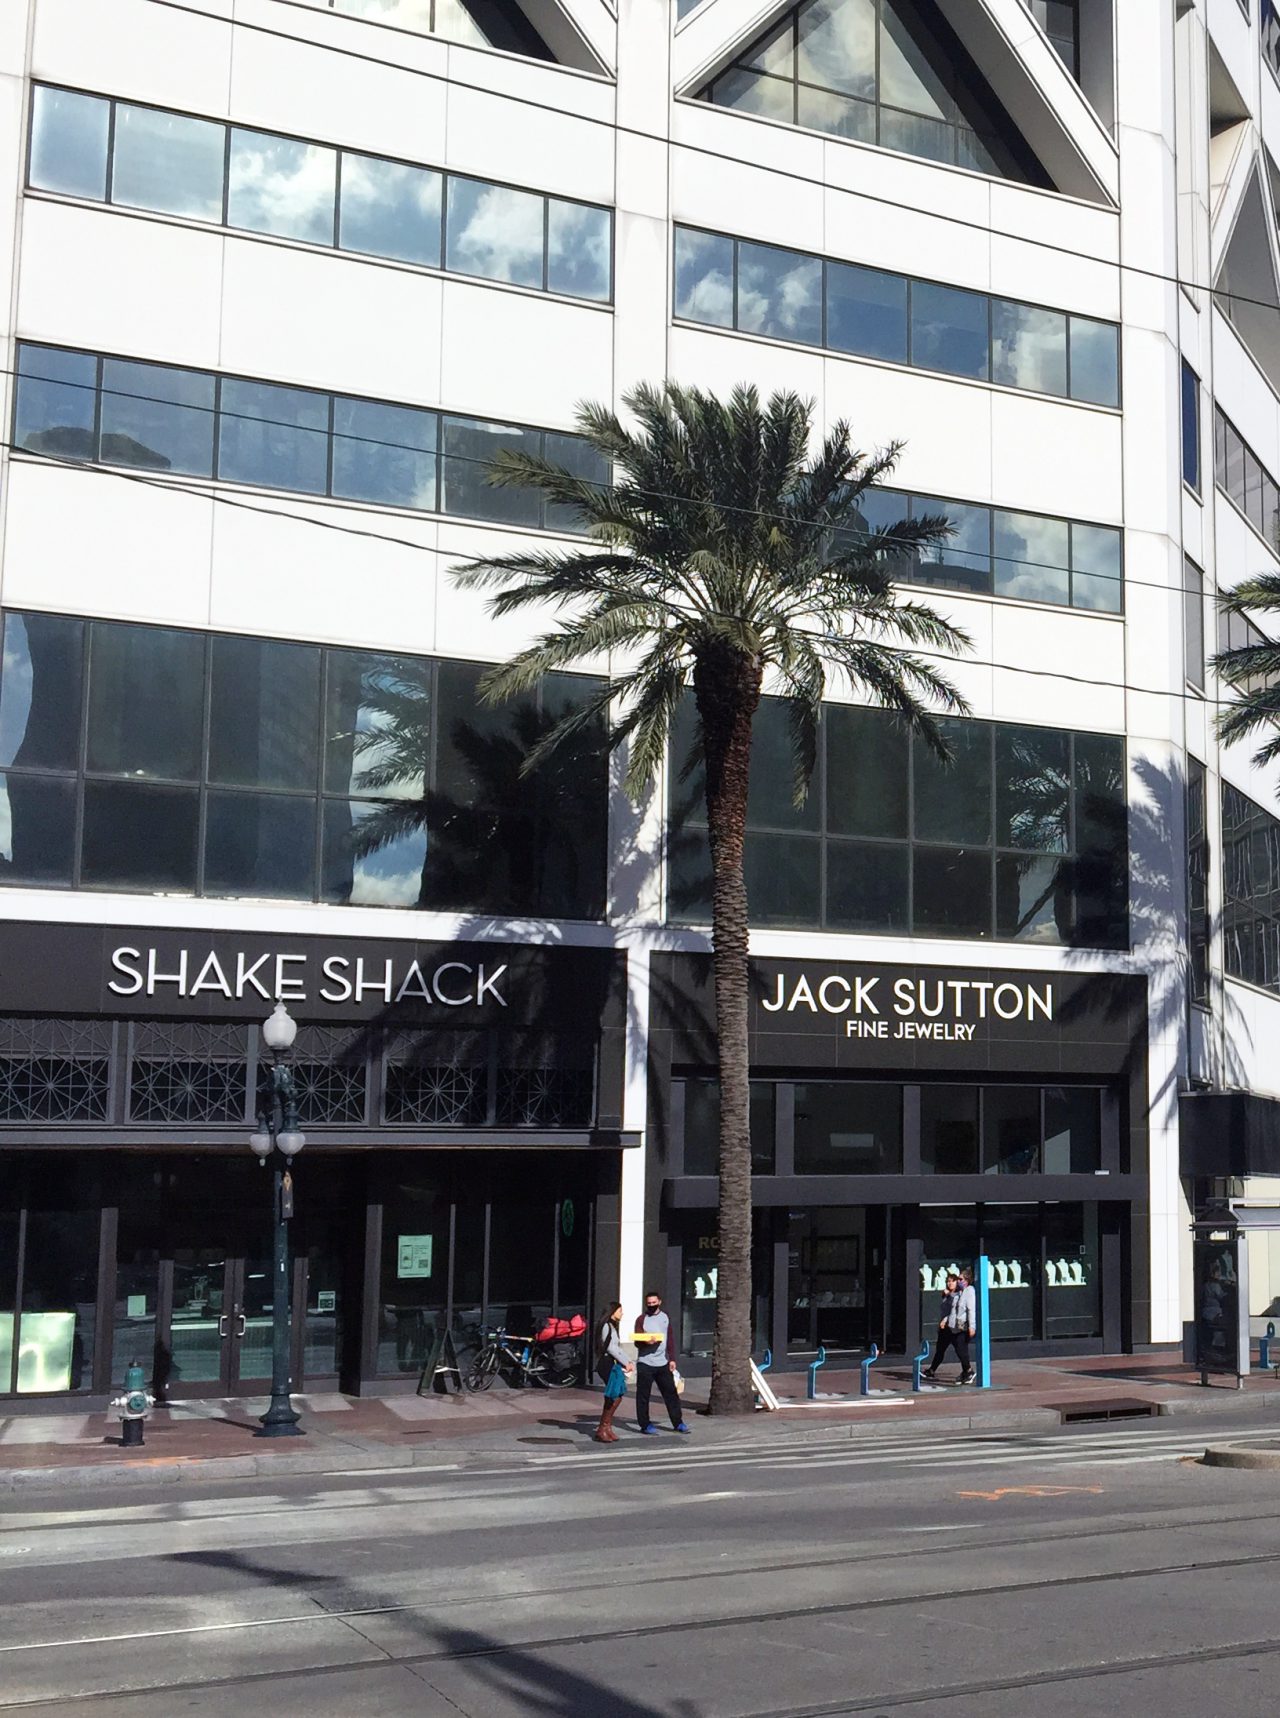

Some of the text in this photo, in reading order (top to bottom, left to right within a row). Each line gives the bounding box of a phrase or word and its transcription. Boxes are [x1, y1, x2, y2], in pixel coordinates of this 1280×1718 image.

[107, 947, 509, 1007] SHAKE SHACK
[762, 974, 1053, 1021] JACK SUTTON
[847, 1020, 976, 1041] FINE JEWELRY
